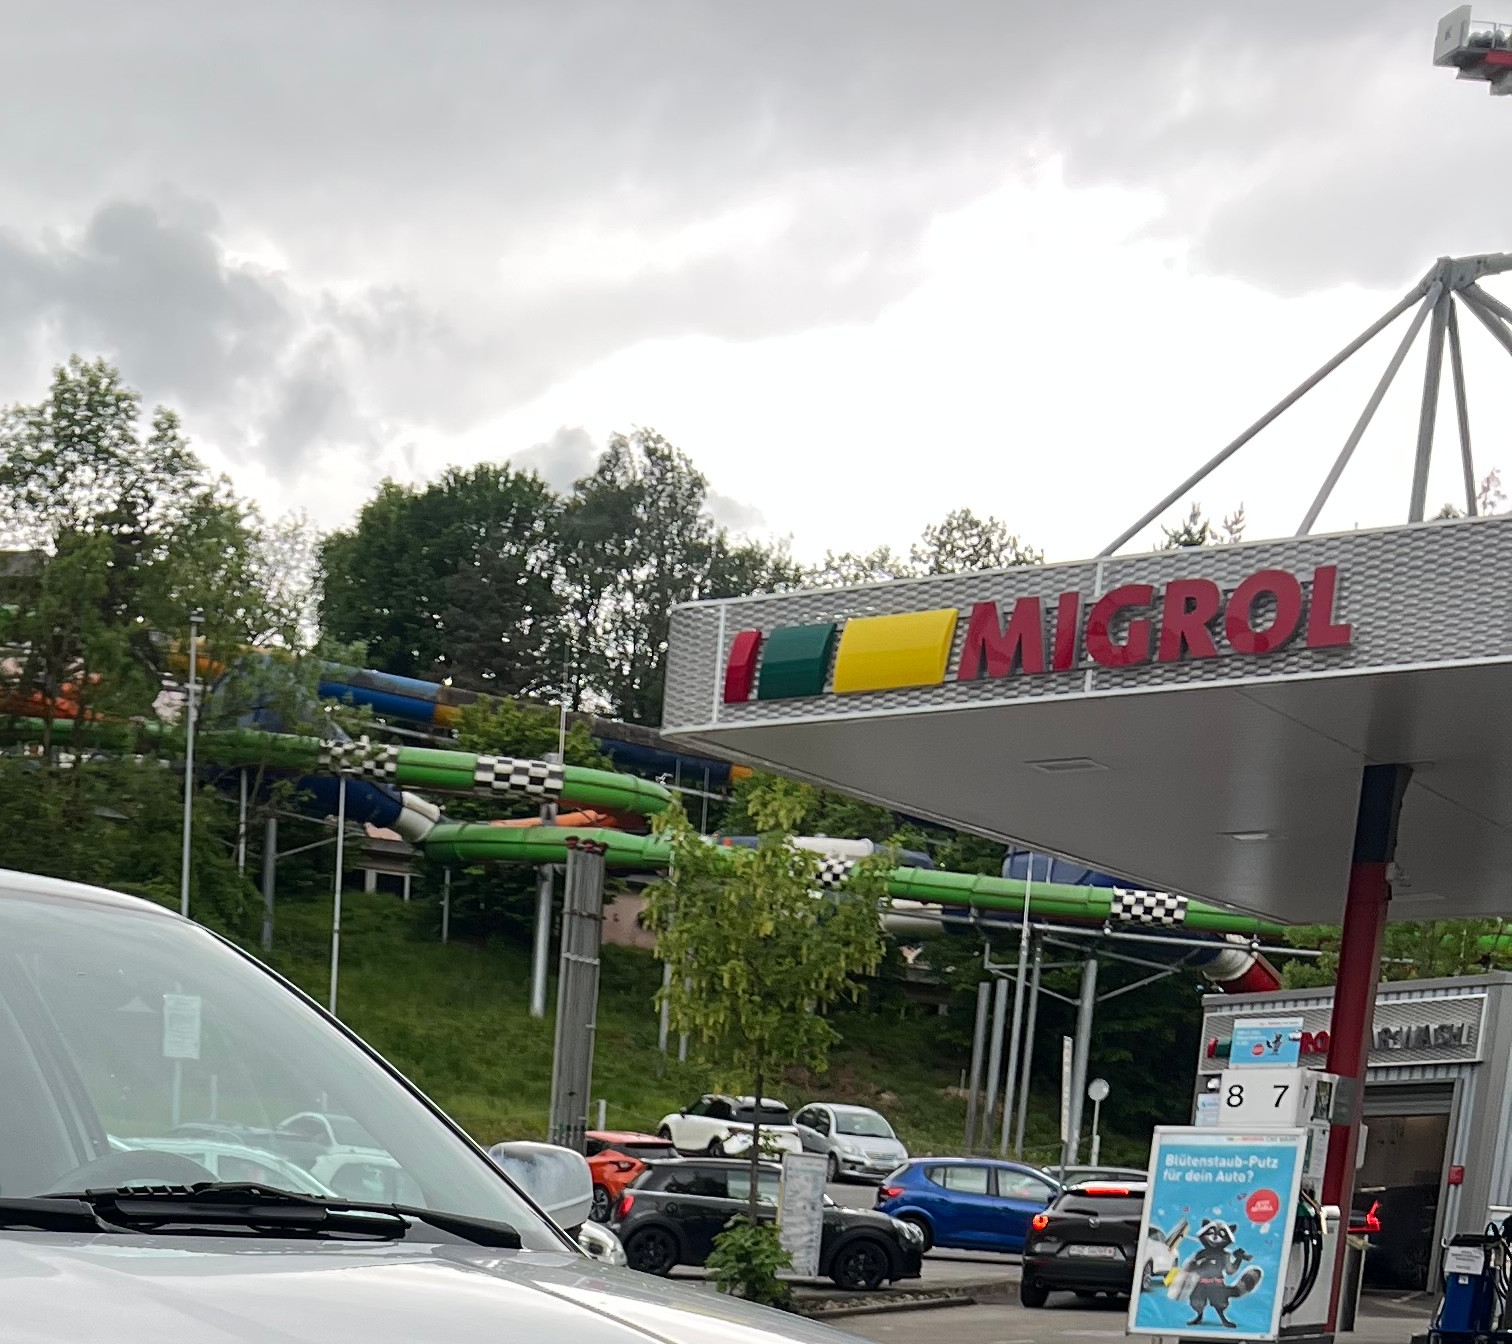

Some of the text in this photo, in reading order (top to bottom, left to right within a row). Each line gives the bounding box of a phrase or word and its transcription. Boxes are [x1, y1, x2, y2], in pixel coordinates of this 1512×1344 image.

[957, 565, 1354, 682] MIGROL
[1227, 1085, 1289, 1108] 8 7
[1165, 1153, 1278, 1169] Blütenstaub-Putz
[1163, 1169, 1255, 1184] für dein Auto?
